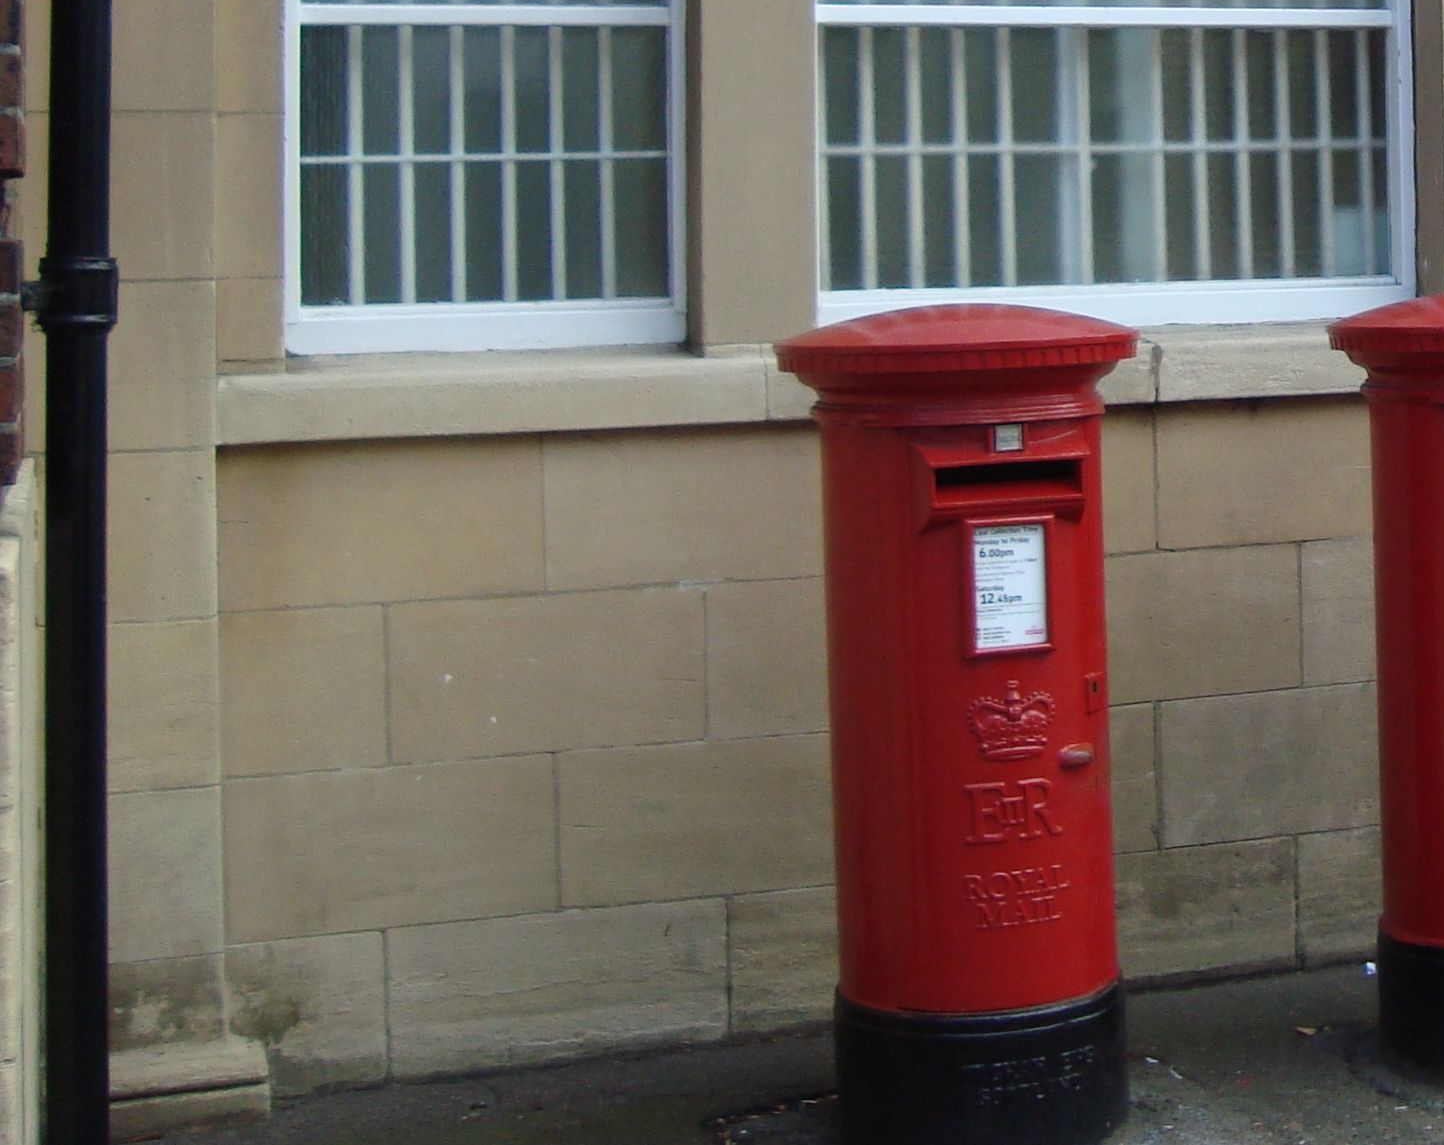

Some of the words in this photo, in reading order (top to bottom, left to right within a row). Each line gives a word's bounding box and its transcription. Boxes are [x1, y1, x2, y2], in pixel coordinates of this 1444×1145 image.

[979, 548, 1014, 559] 6.00pm
[980, 593, 1023, 605] 12.45pm
[963, 864, 1071, 902] ROYAL
[974, 895, 1063, 931] MAIL
